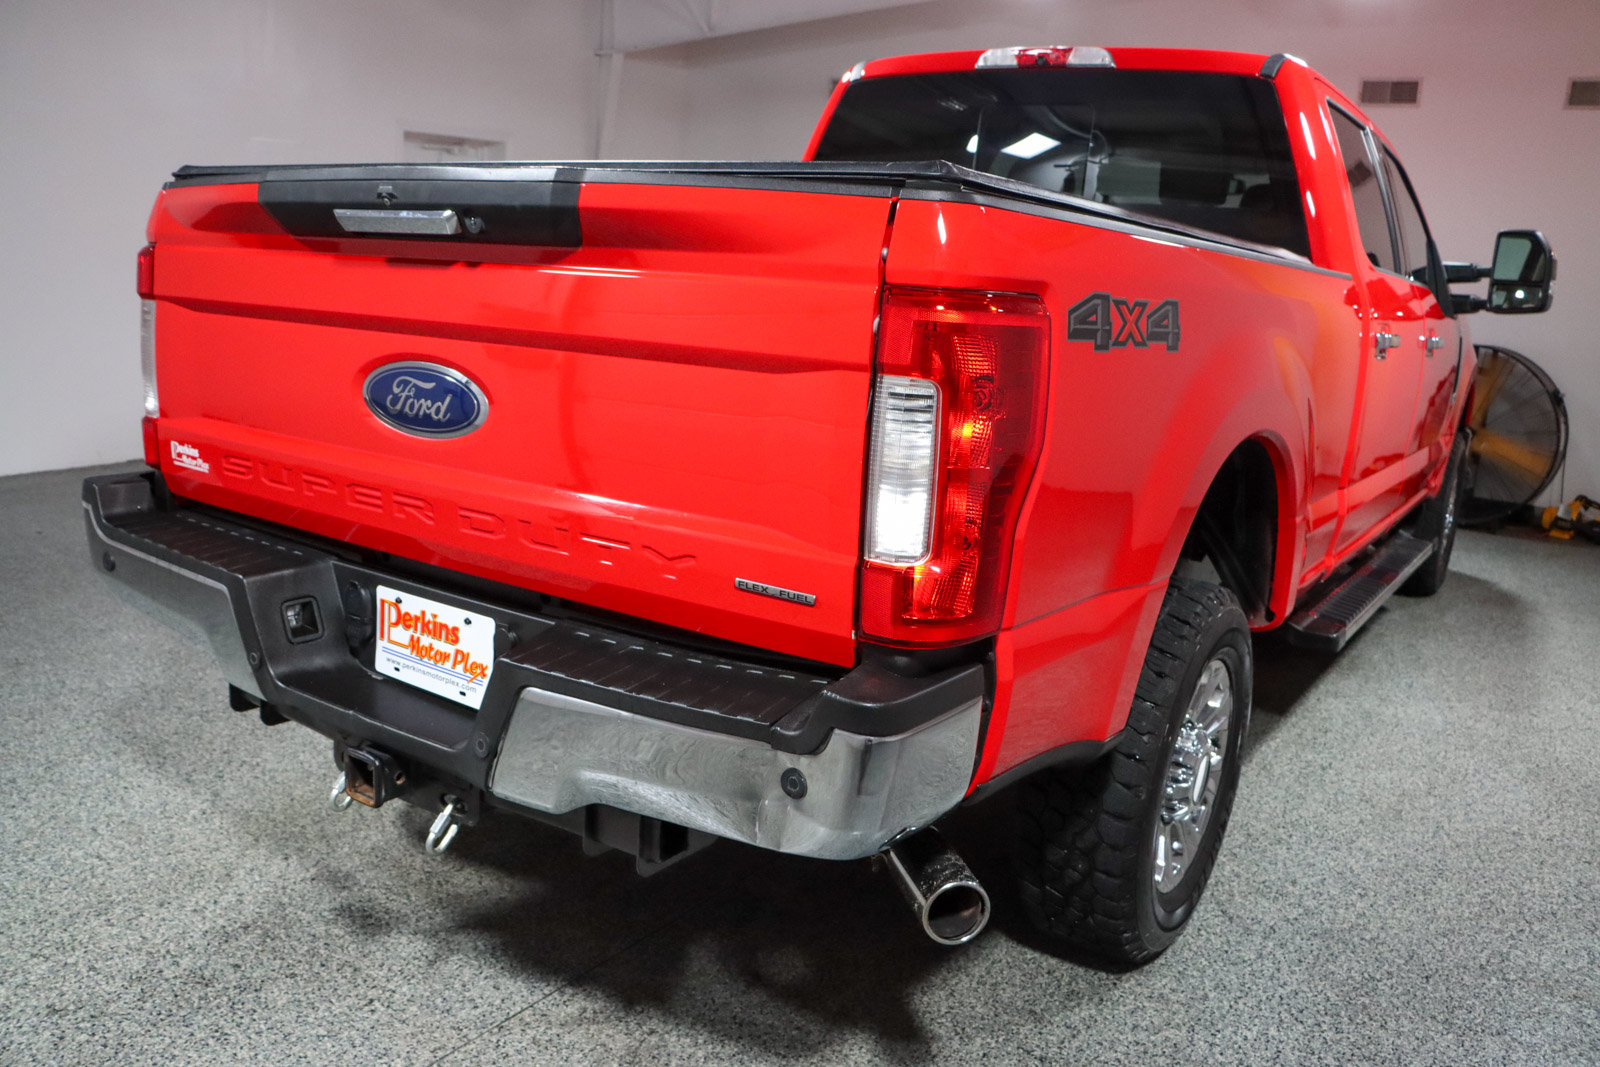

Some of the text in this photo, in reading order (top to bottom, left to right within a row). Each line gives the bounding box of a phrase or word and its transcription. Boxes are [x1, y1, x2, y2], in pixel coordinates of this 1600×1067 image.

[386, 375, 453, 422] Ford
[223, 455, 697, 580] SUPER DUTY
[738, 580, 813, 604] FLEX FUEL
[379, 598, 460, 646] Perkins
[385, 656, 477, 694] www.perkinsmotorplex.com
[408, 634, 488, 683] Motor Plex
